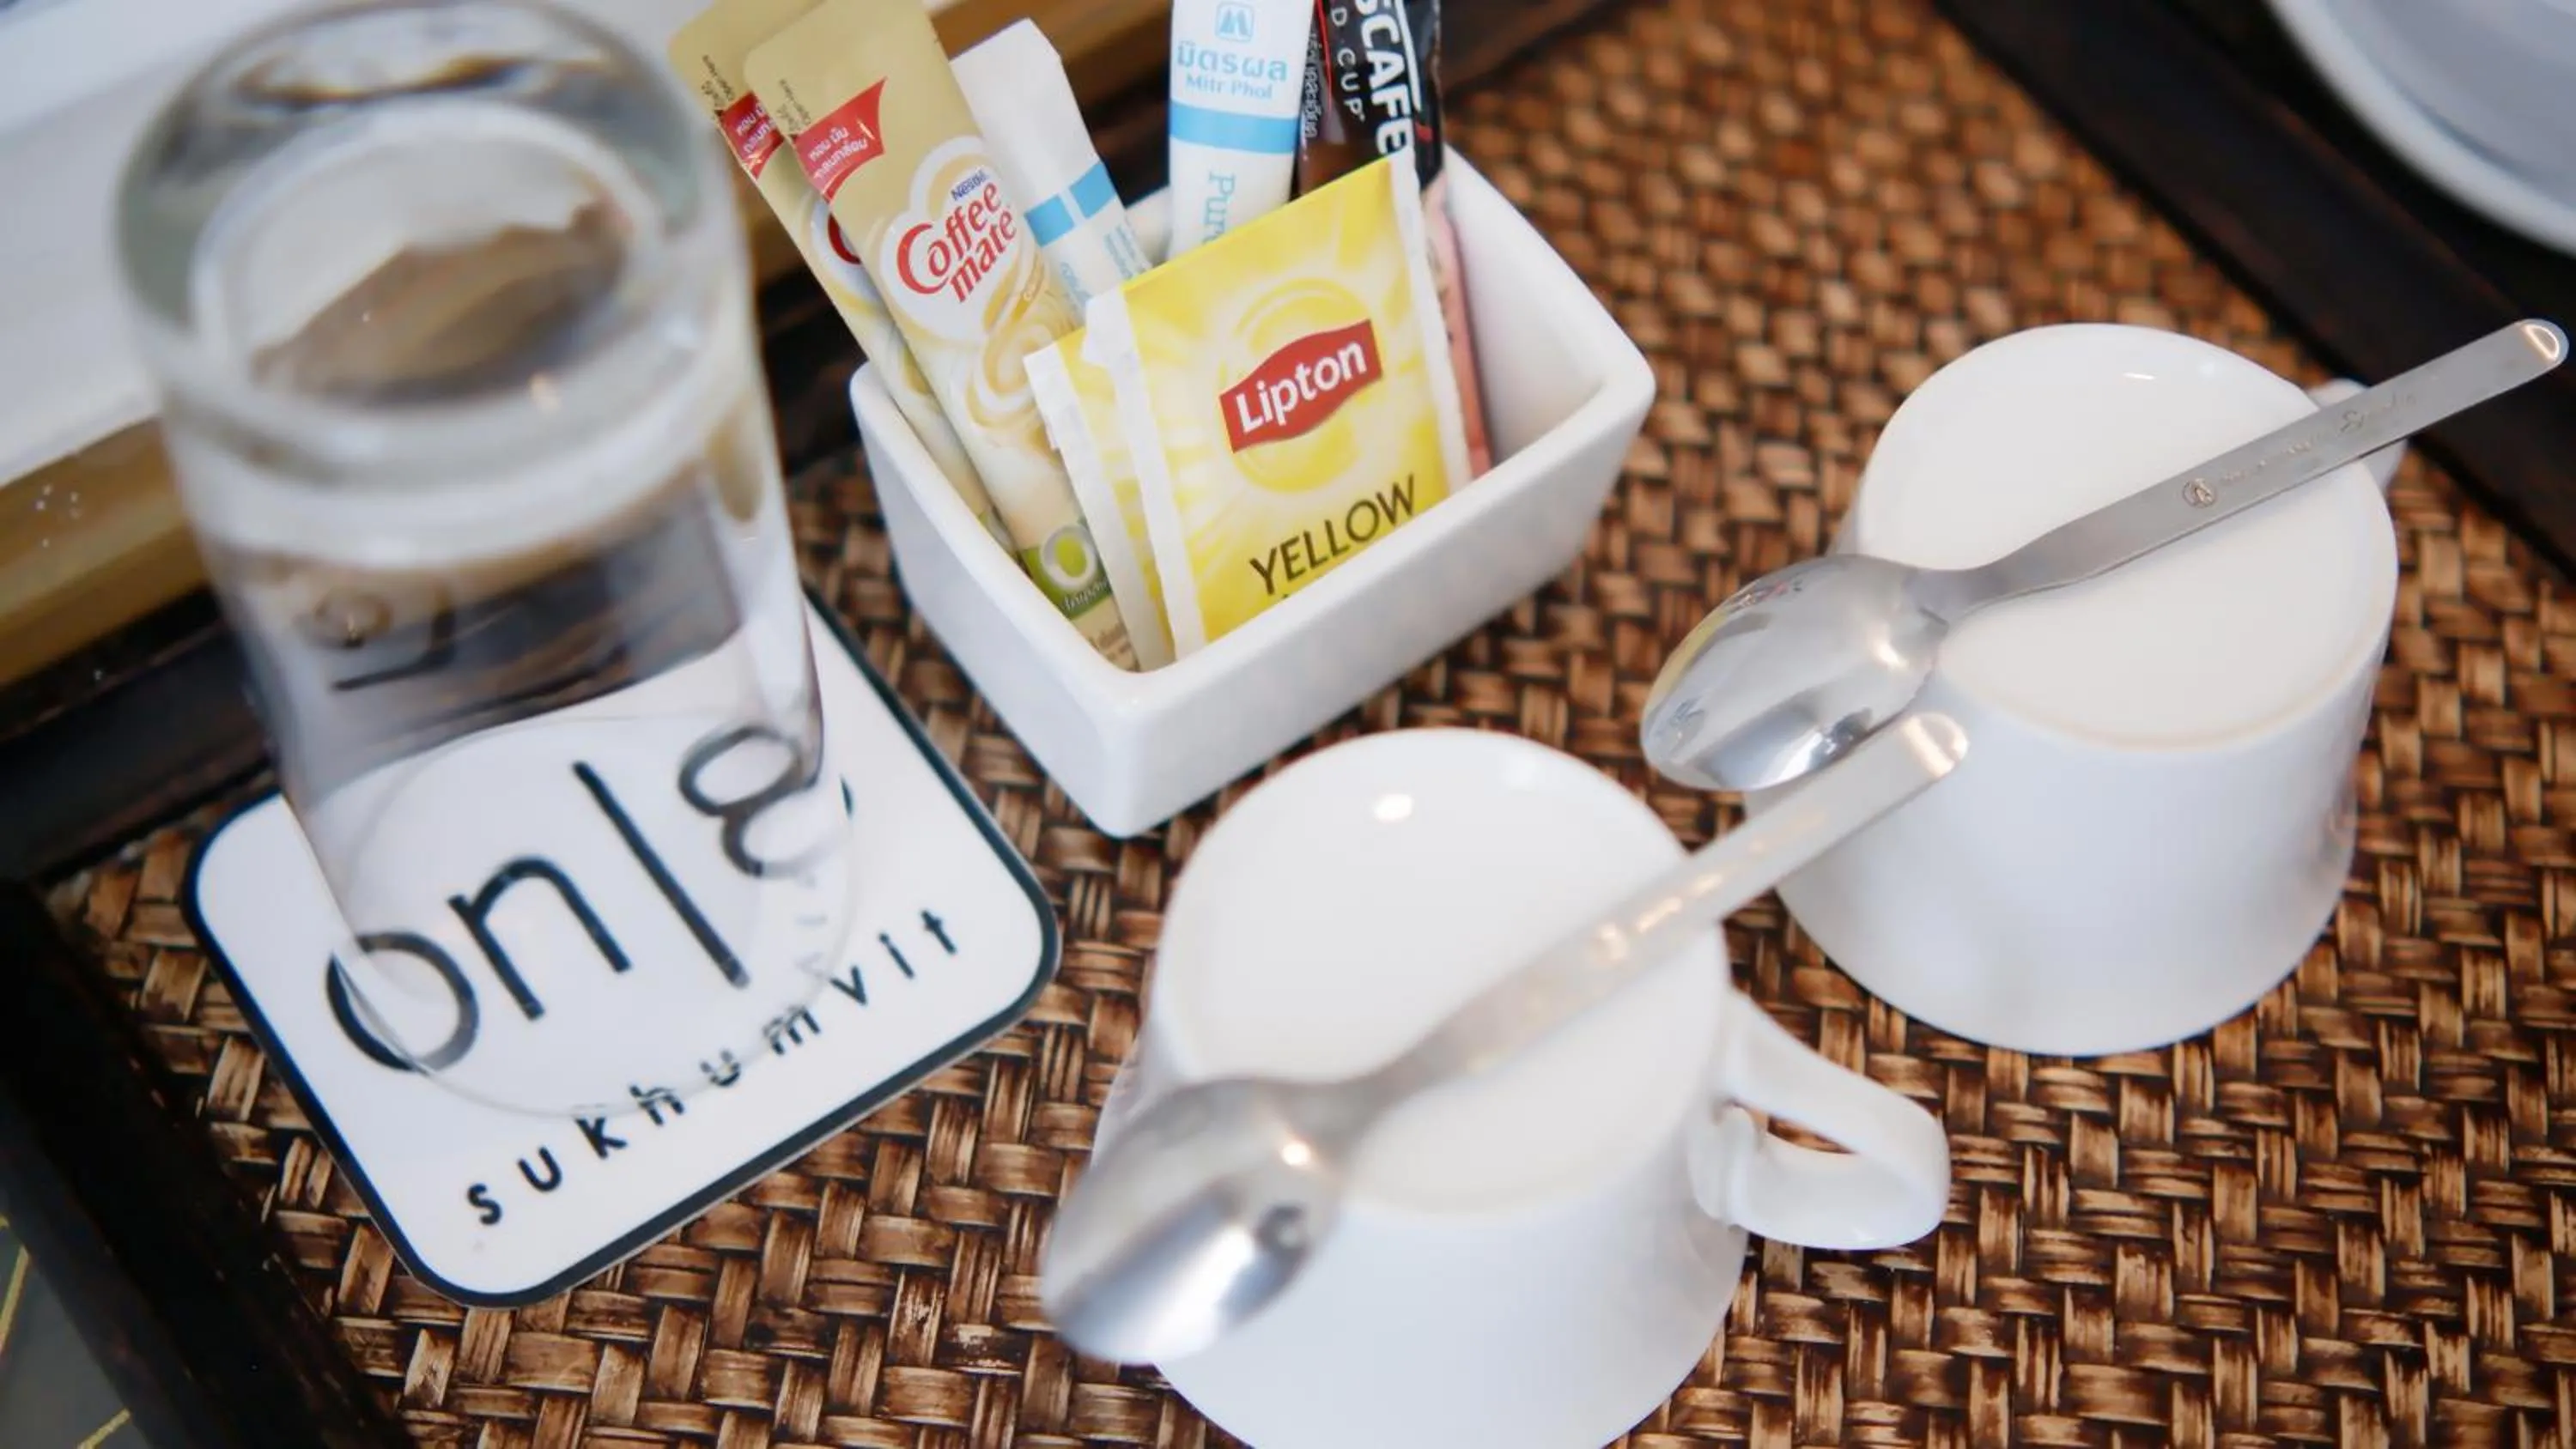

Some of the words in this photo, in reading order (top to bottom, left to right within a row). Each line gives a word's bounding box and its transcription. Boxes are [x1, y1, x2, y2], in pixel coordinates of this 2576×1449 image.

[1177, 41, 1288, 82] มิตรผล
[1186, 73, 1224, 94] Mitr
[1230, 80, 1273, 99] Phol
[896, 182, 1002, 294] Coffee
[1201, 171, 1236, 245] Pur
[948, 209, 1017, 303] mate
[1236, 341, 1368, 434] Lipton
[1249, 473, 1414, 596] YELLOW
[466, 907, 957, 1226] sukhumvit
